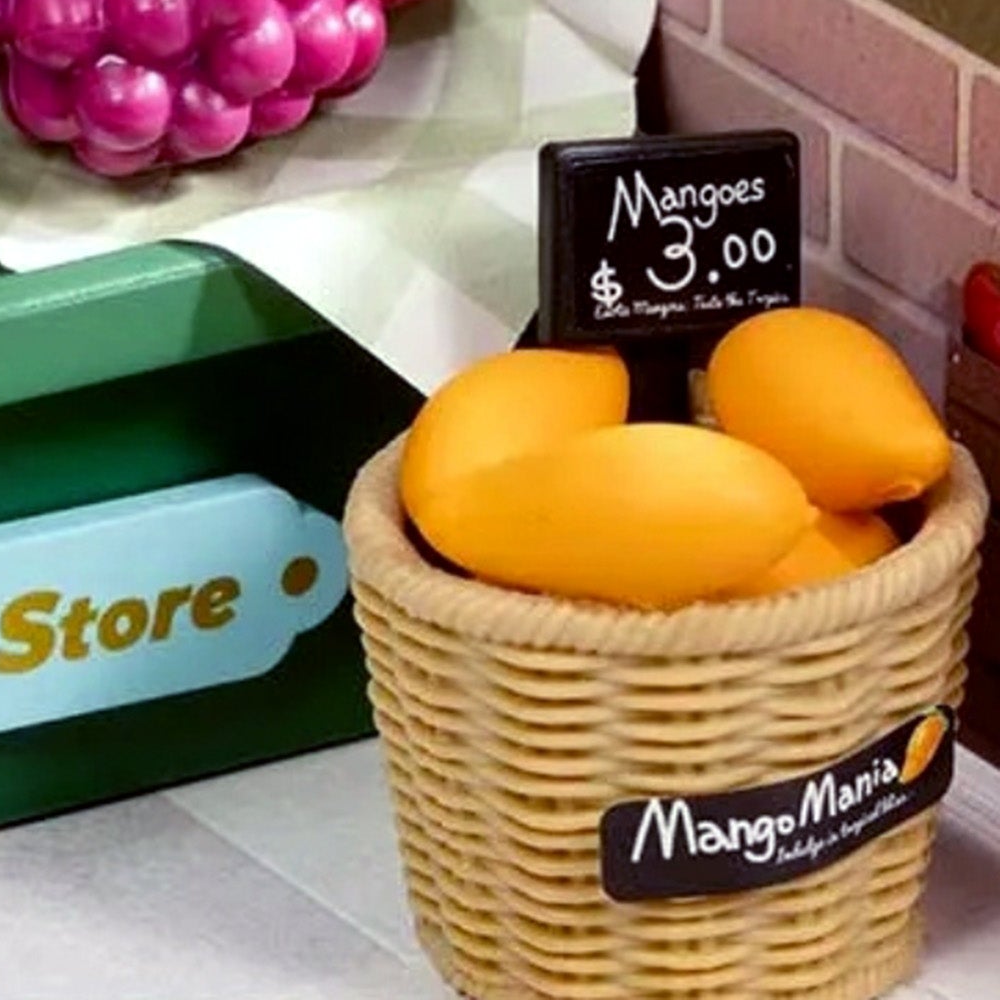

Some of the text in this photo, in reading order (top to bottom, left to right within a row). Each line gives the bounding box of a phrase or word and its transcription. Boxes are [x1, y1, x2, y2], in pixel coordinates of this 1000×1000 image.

[607, 170, 766, 242] Mangoes
[631, 757, 899, 863] Mango Mania
